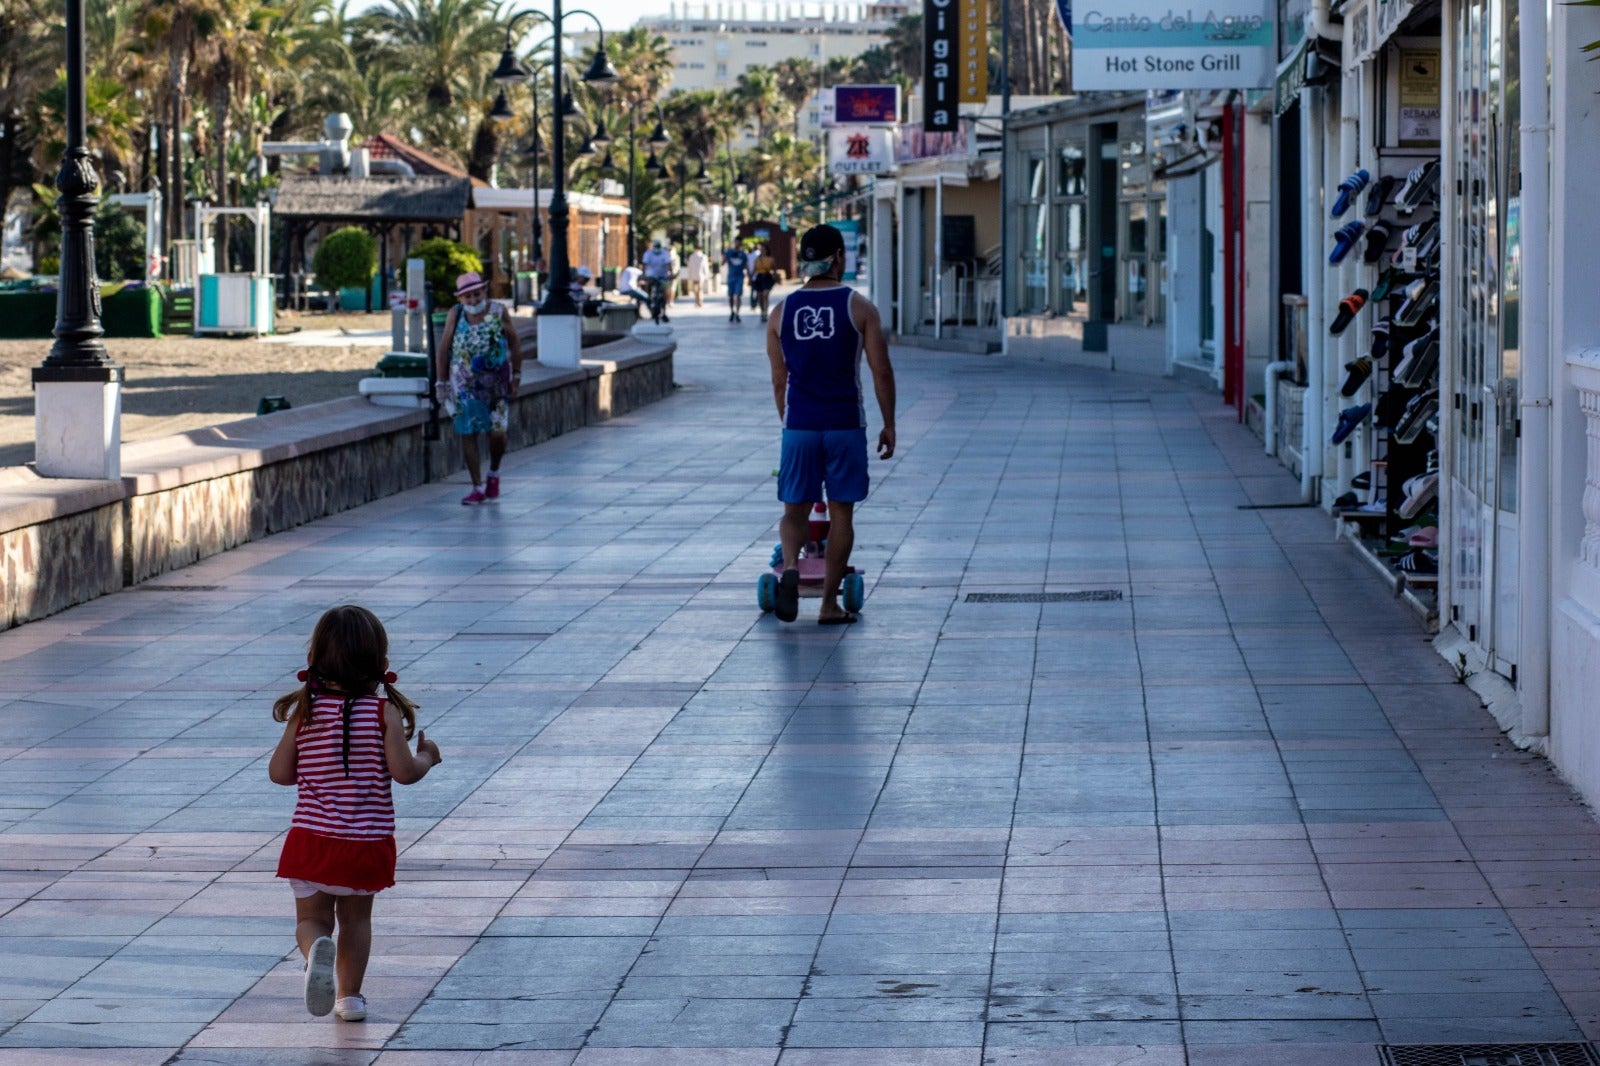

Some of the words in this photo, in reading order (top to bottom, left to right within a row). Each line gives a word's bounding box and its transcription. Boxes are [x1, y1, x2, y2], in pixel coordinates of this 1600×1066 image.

[1083, 10, 1151, 33] Canto
[1159, 9, 1192, 32] del
[1202, 9, 1262, 33] Agua
[1106, 56, 1137, 72] Hot
[1144, 55, 1195, 72] Stone
[1201, 53, 1240, 71] Grill
